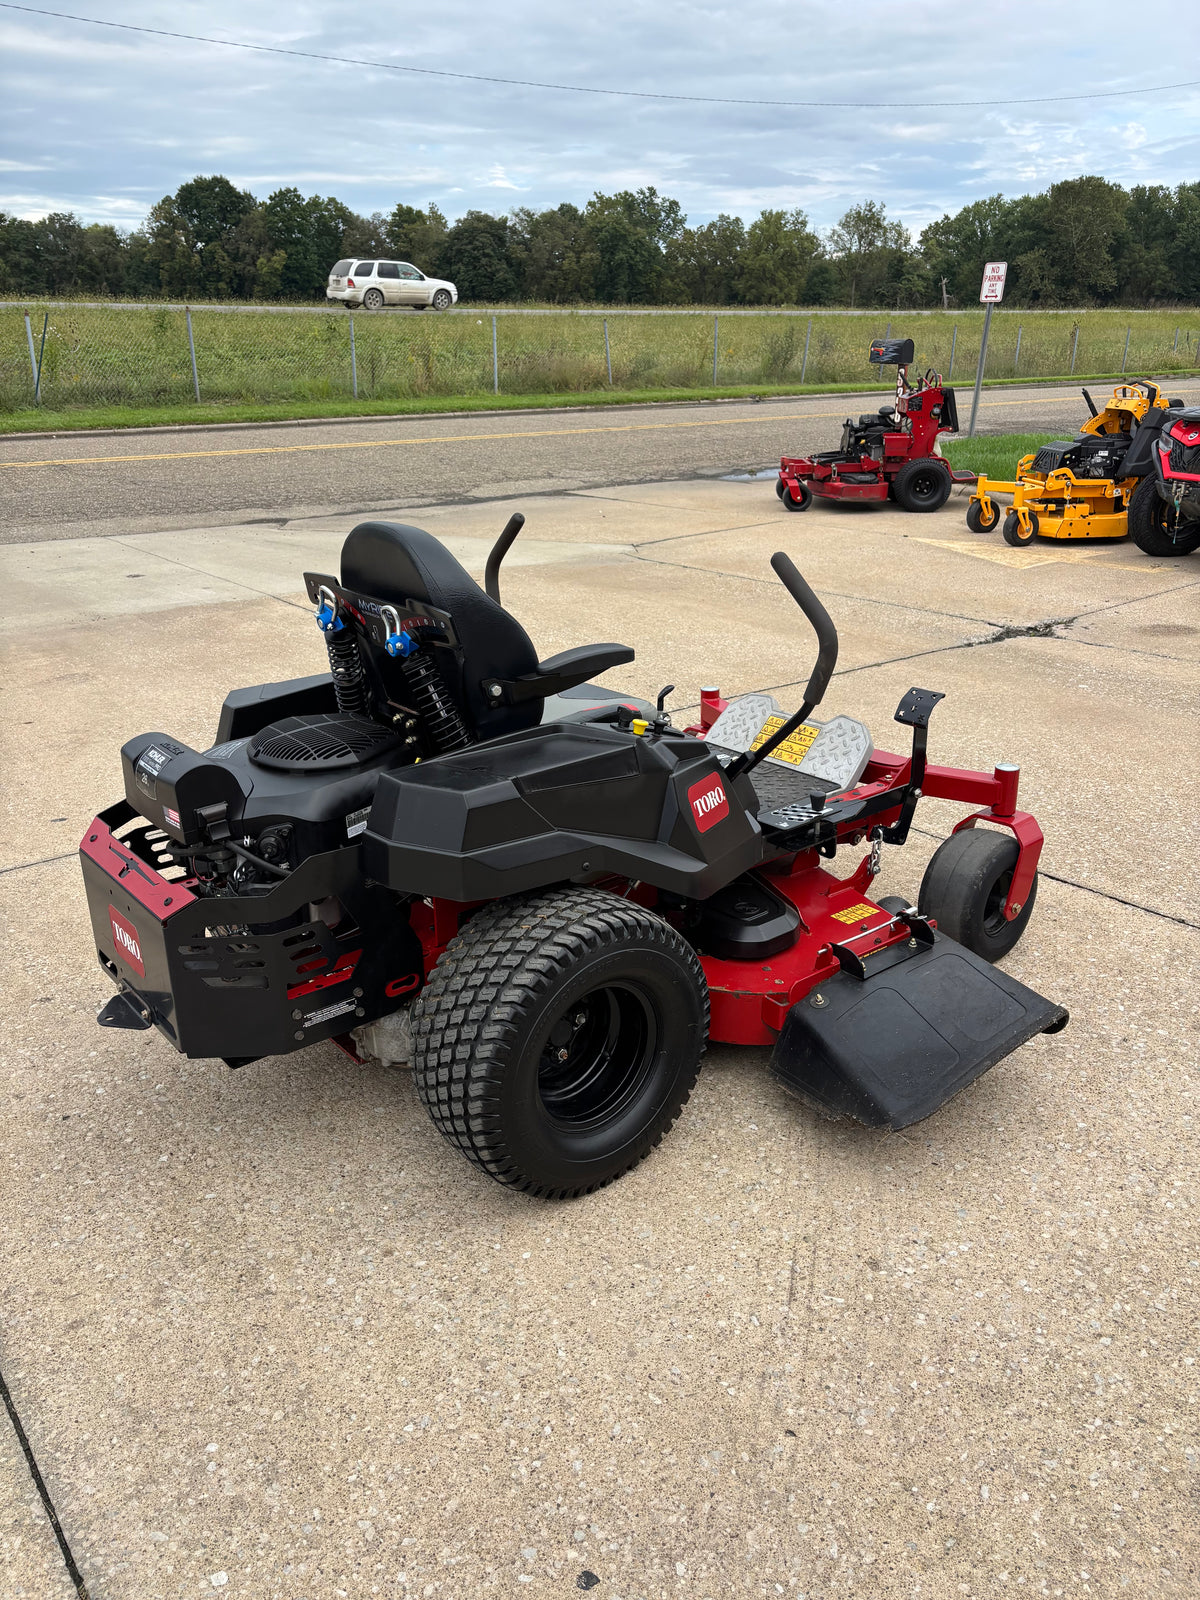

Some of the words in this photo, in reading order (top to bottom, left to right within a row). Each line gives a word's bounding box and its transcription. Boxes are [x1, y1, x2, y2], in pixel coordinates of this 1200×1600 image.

[991, 266, 1000, 274] NO
[693, 786, 724, 818] TORO
[112, 920, 141, 960] TORO
